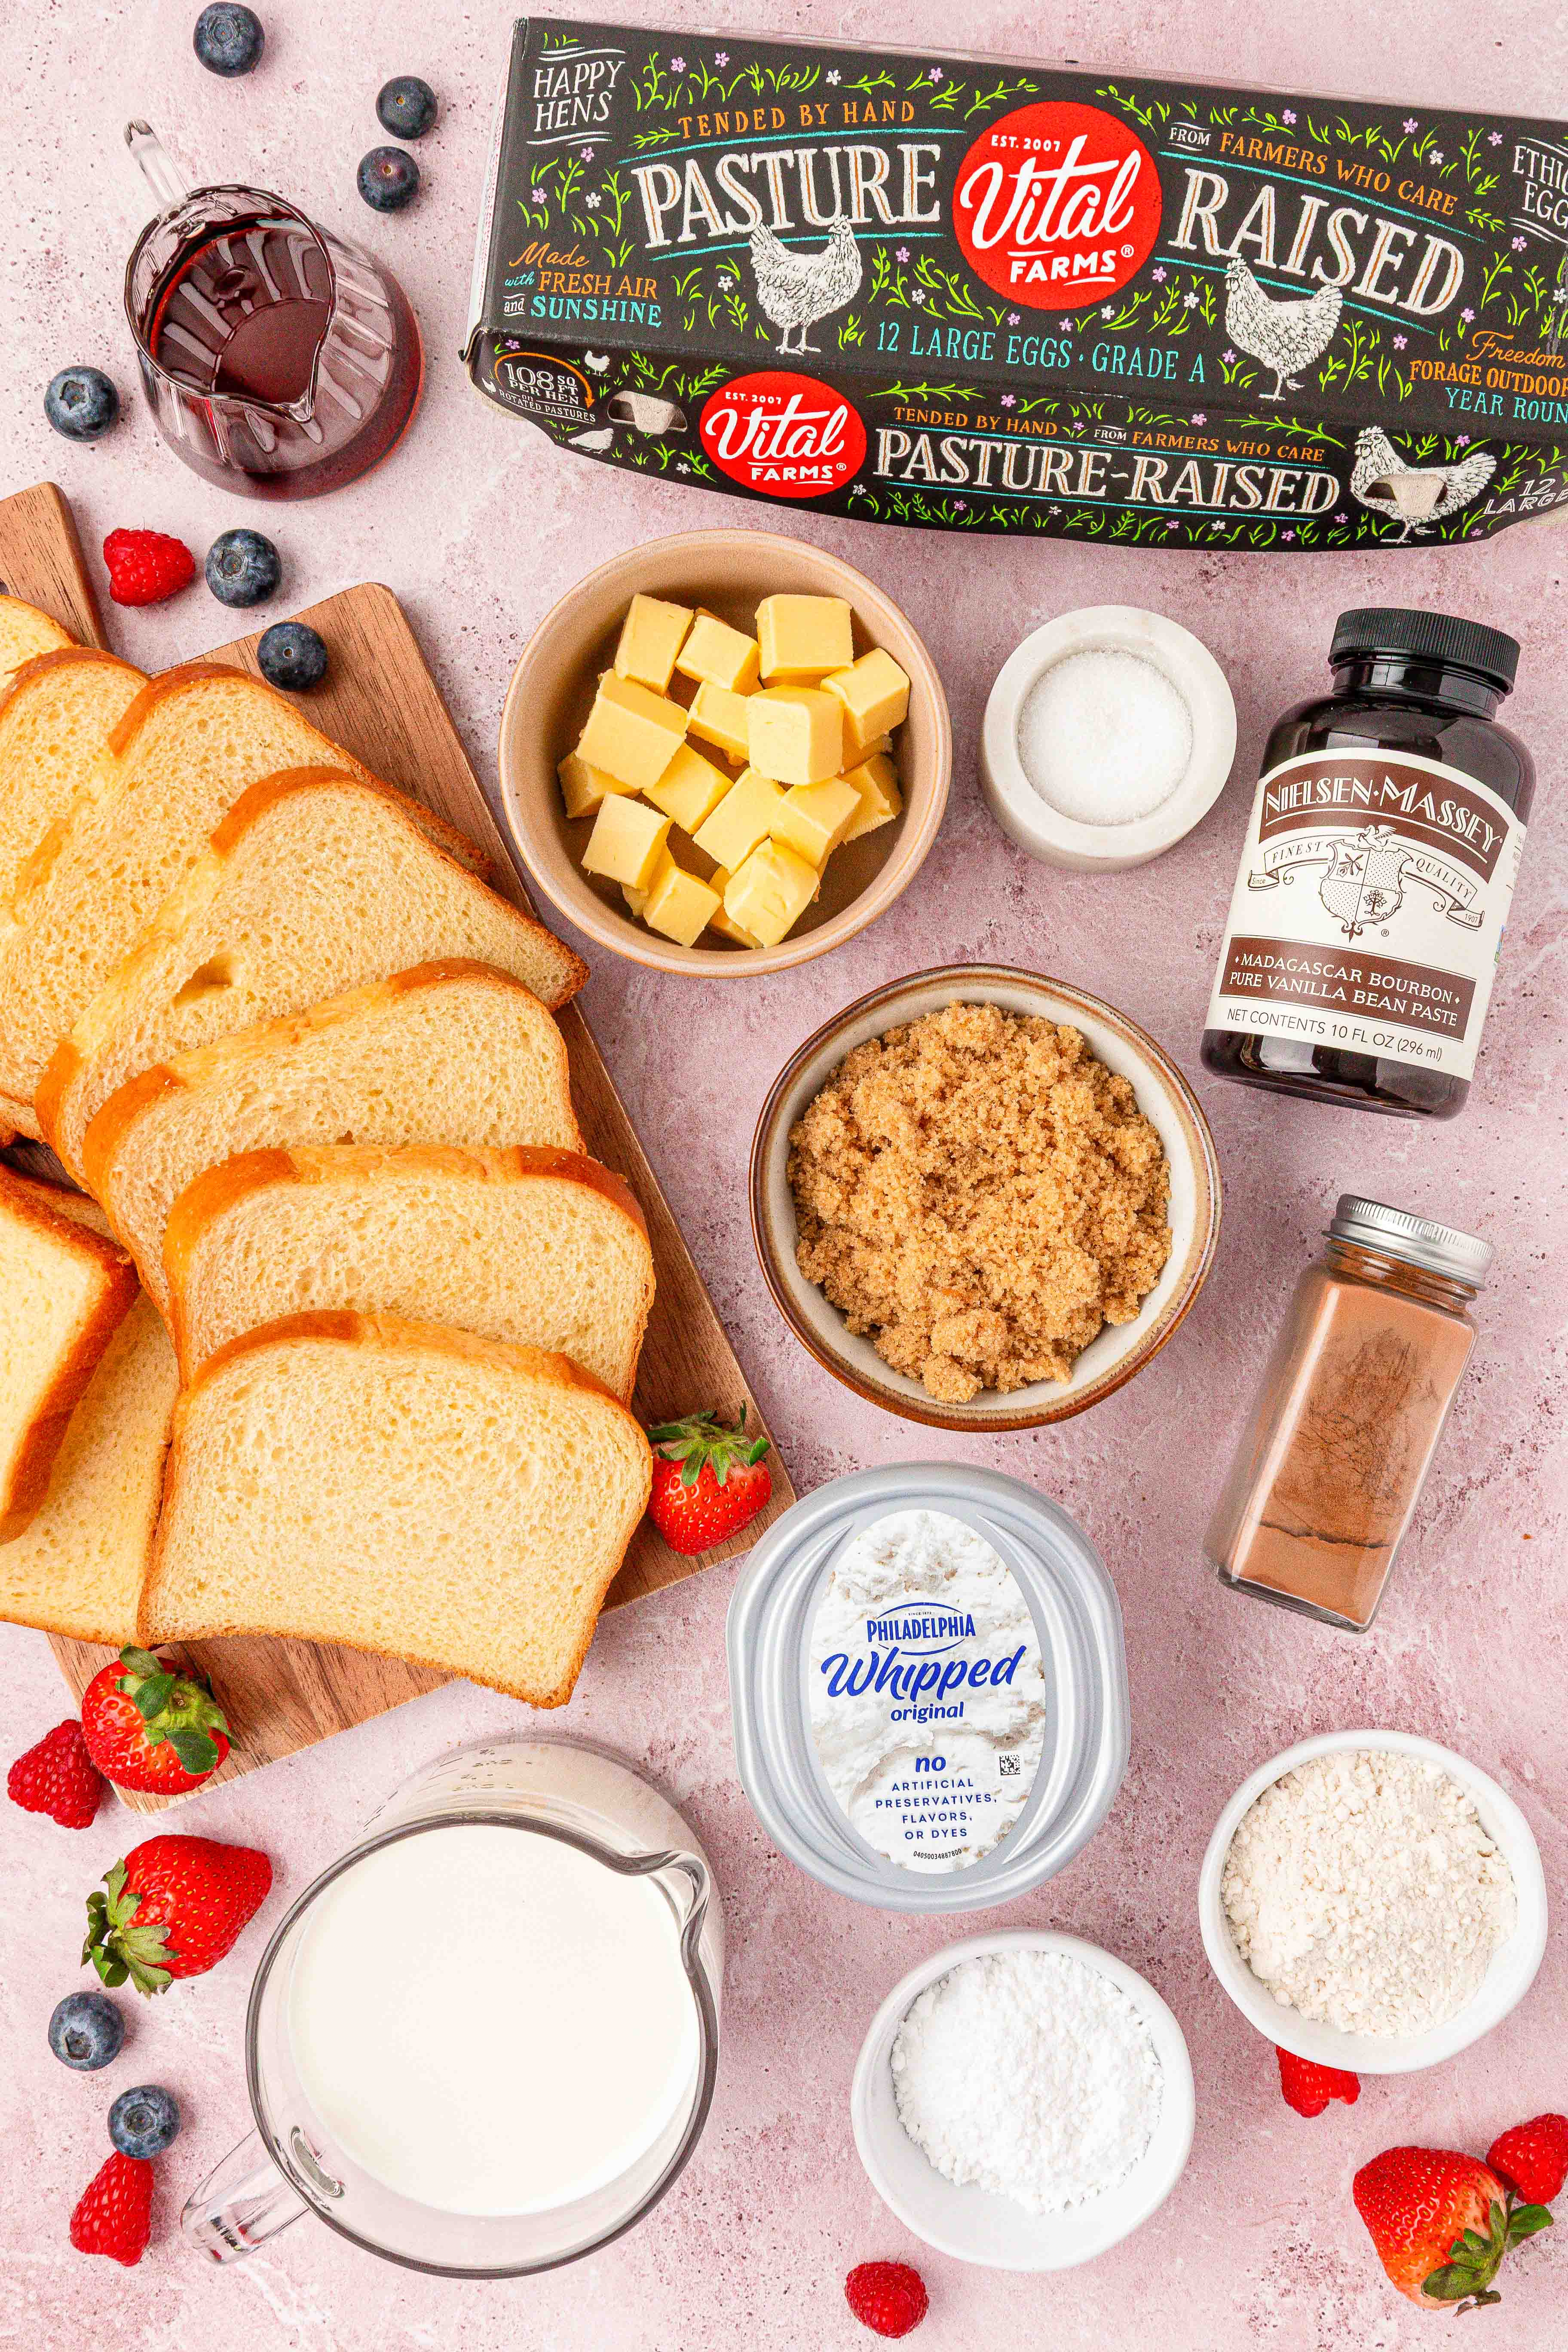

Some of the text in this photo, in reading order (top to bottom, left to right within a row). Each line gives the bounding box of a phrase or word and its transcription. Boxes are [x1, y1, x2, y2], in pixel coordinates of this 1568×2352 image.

[533, 61, 626, 98] HAPPY
[534, 91, 612, 132] HENS
[678, 101, 915, 139] TENDED BY HAND
[991, 135, 1061, 152] EST. 2007
[1169, 127, 1458, 216] FROM FARMERS WHO CARE
[631, 144, 940, 248] PASTURE
[960, 134, 1141, 249] Vital
[509, 242, 590, 268] Made
[1167, 168, 1465, 316] RAISED
[505, 271, 658, 300] with FRESH AIR
[504, 295, 662, 328] and SUNSHINE
[877, 322, 1205, 383] 12 LARGE EGGS GRADE A
[1466, 331, 1565, 369] Freedom
[504, 363, 578, 395] 108 SQ FT
[1409, 360, 1482, 386] FORAGE
[499, 389, 596, 422] ROTATED PASTURES
[508, 379, 579, 405] PER HEN
[725, 392, 782, 405] EST. 2007
[1445, 387, 1503, 416] YEAR
[705, 394, 848, 461] Vital
[894, 407, 1324, 461] TENDED BY HAND FROM FARMERS WHO CARE
[873, 428, 1339, 513] PASTURE-RAISED
[1519, 478, 1556, 496] 12
[1273, 841, 1472, 899] FINEST QUALITY
[1465, 913, 1478, 923] 1907
[1240, 953, 1453, 1004] MADAGASCAR BOURBON
[1229, 972, 1458, 1027] PURE VANILLA BEAN PASTE
[1228, 1008, 1442, 1062] NET CONTENTS 10 FL OZ (296 ml)
[867, 1614, 976, 1642] PHILADELPHIA
[821, 1645, 1027, 1702] Whipped
[891, 1702, 964, 1724] original
[915, 1756, 946, 1772] no
[875, 1793, 997, 1809] PRESERVATIVES,
[891, 1778, 974, 1792] ARTIFICIAL
[902, 1812, 973, 1824] FLAVORS,
[904, 1828, 968, 1841] OR DYES
[913, 1848, 962, 1859] 04050034887800
